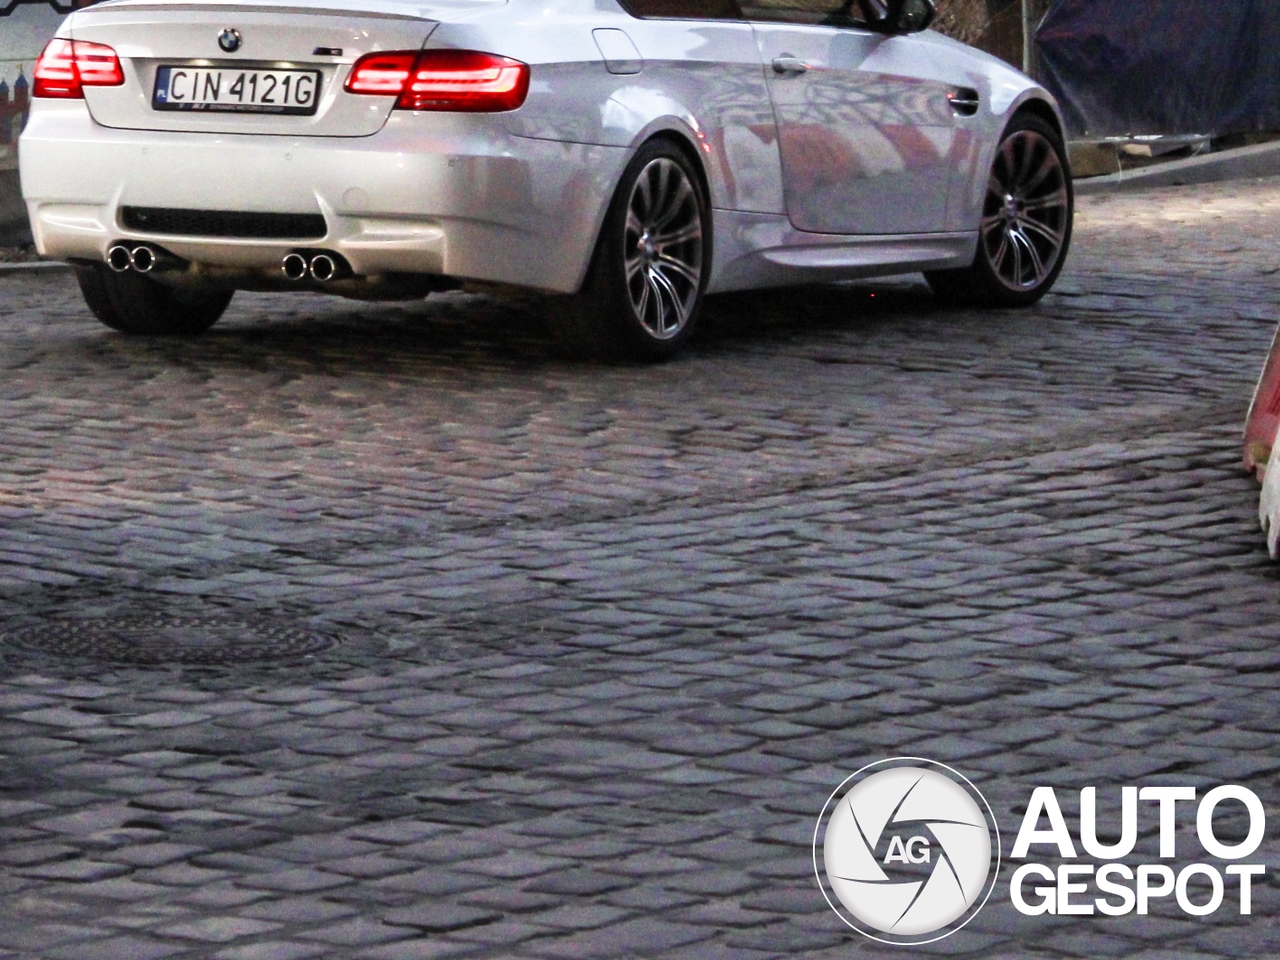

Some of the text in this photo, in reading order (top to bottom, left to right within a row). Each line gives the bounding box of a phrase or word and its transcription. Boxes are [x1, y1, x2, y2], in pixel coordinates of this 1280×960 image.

[156, 89, 167, 98] PL
[171, 71, 313, 105] CIN 4121G
